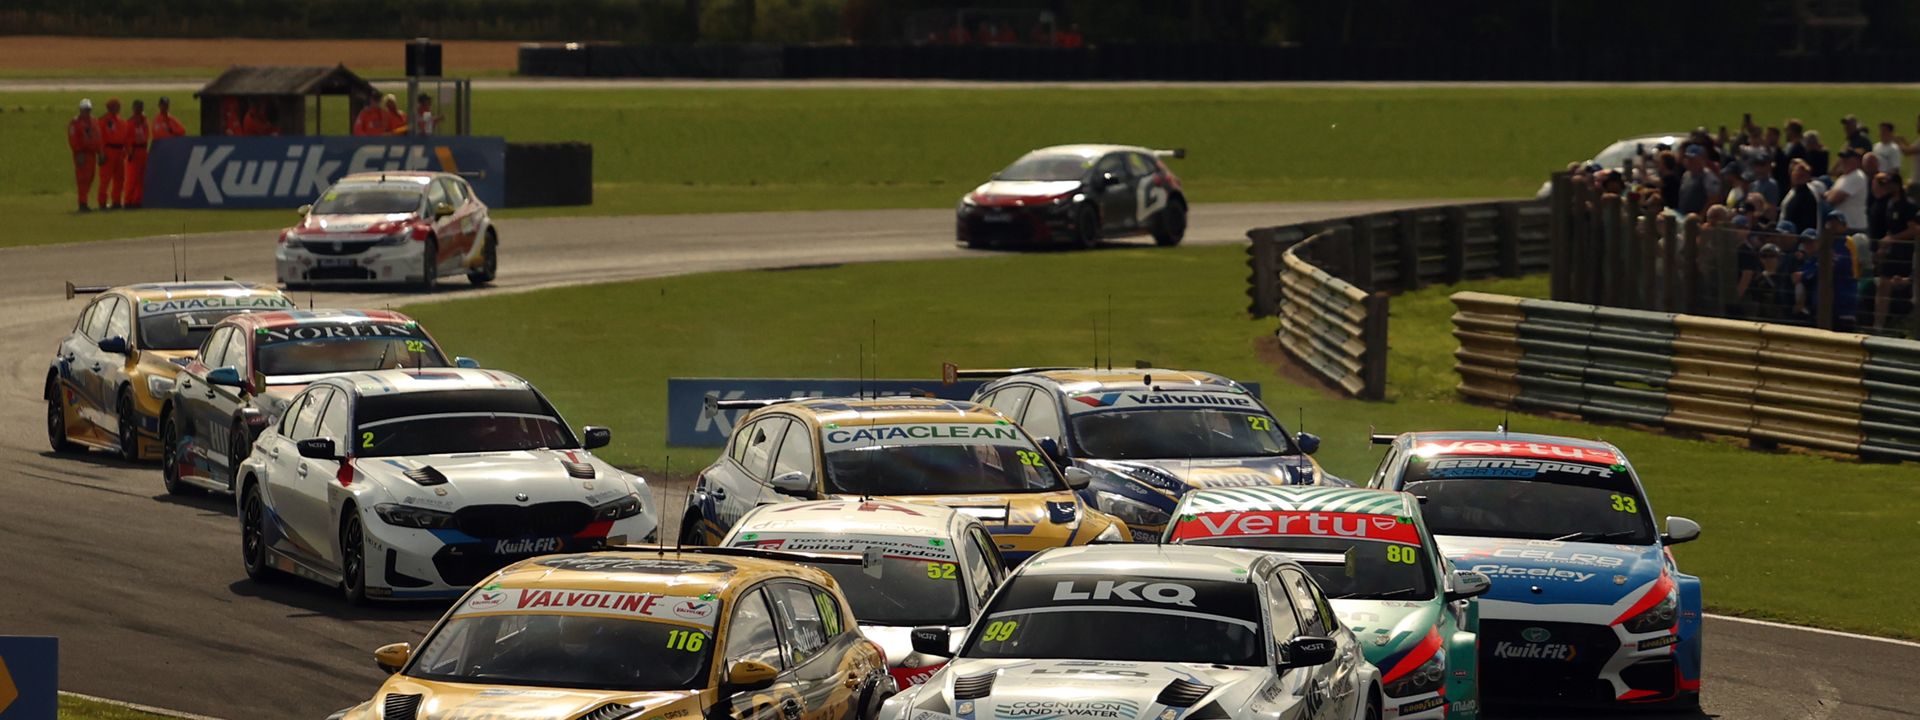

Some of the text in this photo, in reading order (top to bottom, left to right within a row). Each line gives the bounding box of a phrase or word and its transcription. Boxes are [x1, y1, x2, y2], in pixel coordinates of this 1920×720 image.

[143, 299, 287, 313] CATACLEAN
[405, 341, 426, 353] 22
[1129, 393, 1250, 407] Valvoline
[1248, 416, 1270, 431] 27
[362, 432, 374, 448] 2
[827, 426, 1018, 444] CATACLEAN
[1016, 450, 1045, 467] 32
[1611, 494, 1637, 513] 33
[1387, 544, 1416, 564] 80
[927, 563, 957, 579] 52
[516, 589, 664, 615] VALVOLINE
[1052, 580, 1198, 607] LKQ
[982, 621, 1018, 642] 99
[666, 629, 706, 652] 116
[1012, 702, 1121, 711] COGNITION
